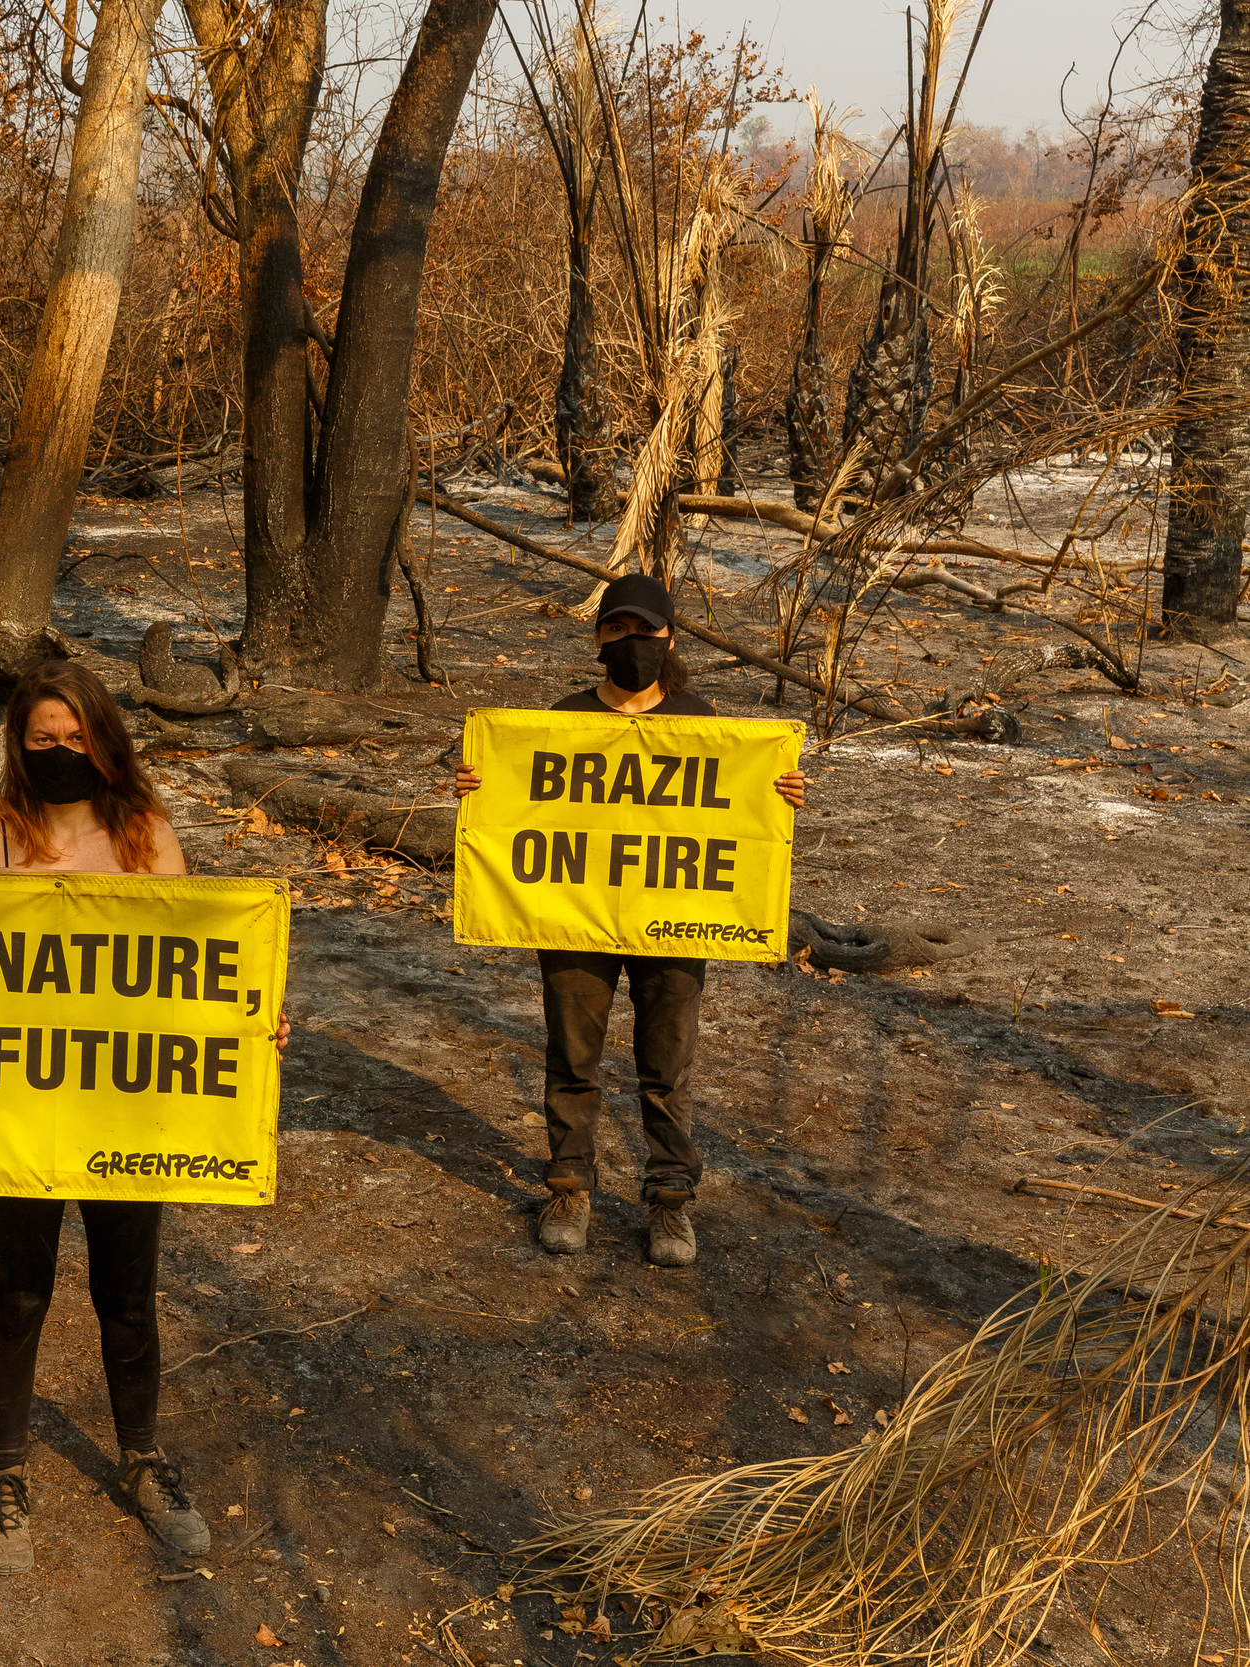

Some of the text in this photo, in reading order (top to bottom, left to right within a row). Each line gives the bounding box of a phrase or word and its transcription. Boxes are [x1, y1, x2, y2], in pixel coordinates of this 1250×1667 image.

[529, 751, 731, 809] BRAZIL
[511, 829, 738, 893] ON FIRE
[645, 919, 775, 944] GREENPEACE
[87, 1151, 259, 1181] GREENPEACE
